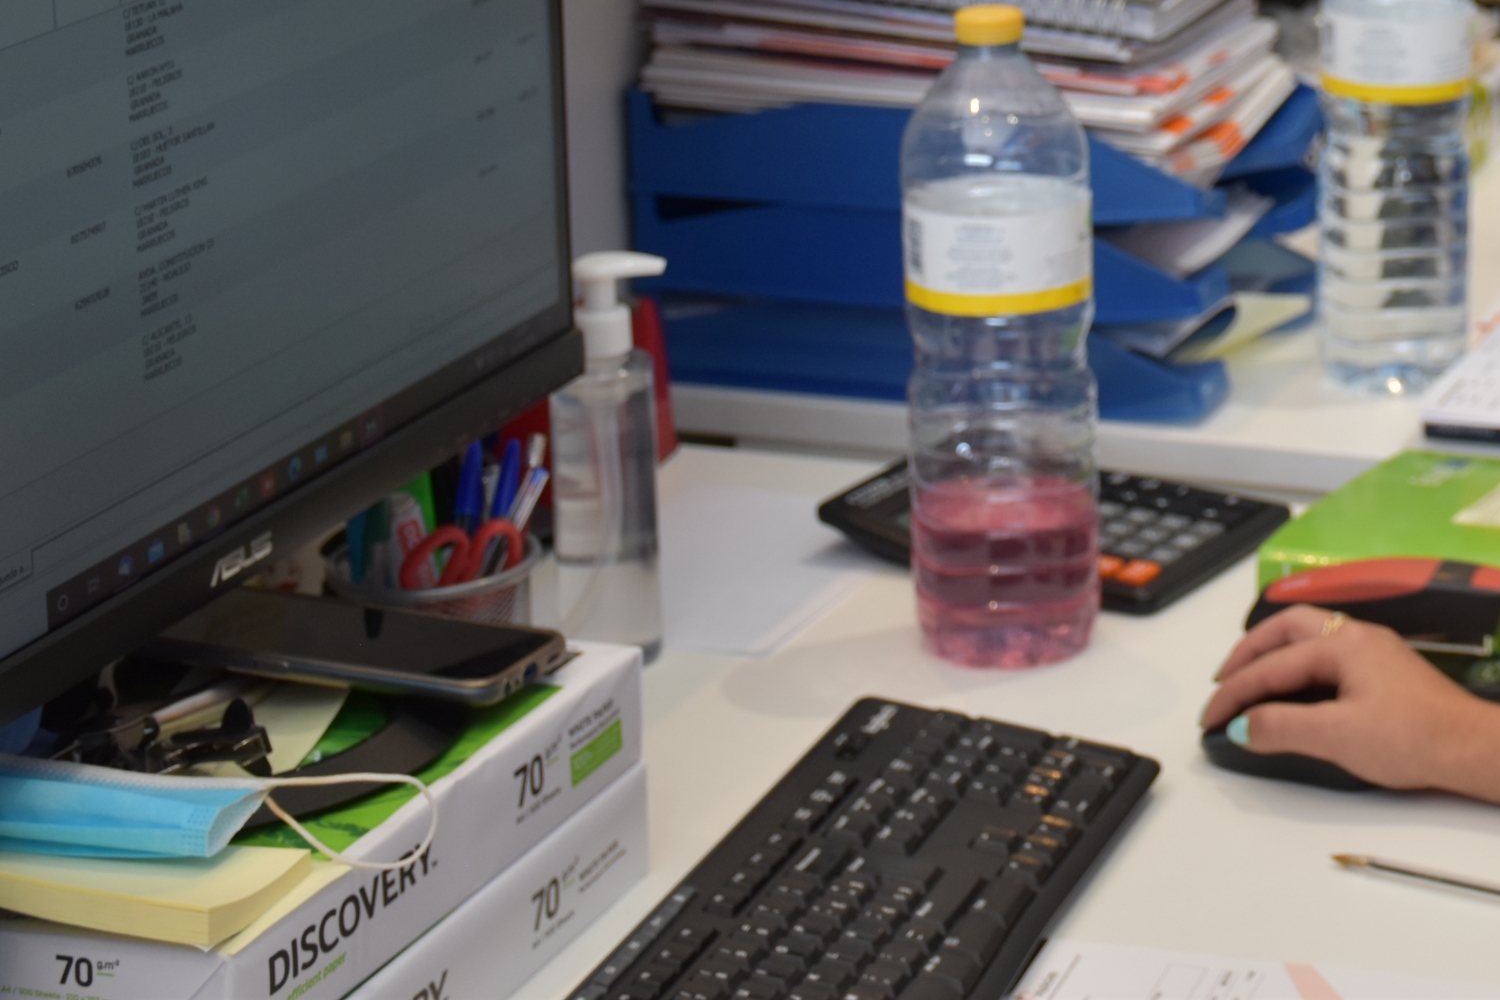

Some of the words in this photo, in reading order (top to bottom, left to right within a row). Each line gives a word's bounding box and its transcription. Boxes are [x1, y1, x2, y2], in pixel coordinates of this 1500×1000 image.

[210, 530, 273, 588] ASUS
[513, 753, 544, 809] 70
[530, 877, 560, 932] 70
[55, 953, 94, 988] 70
